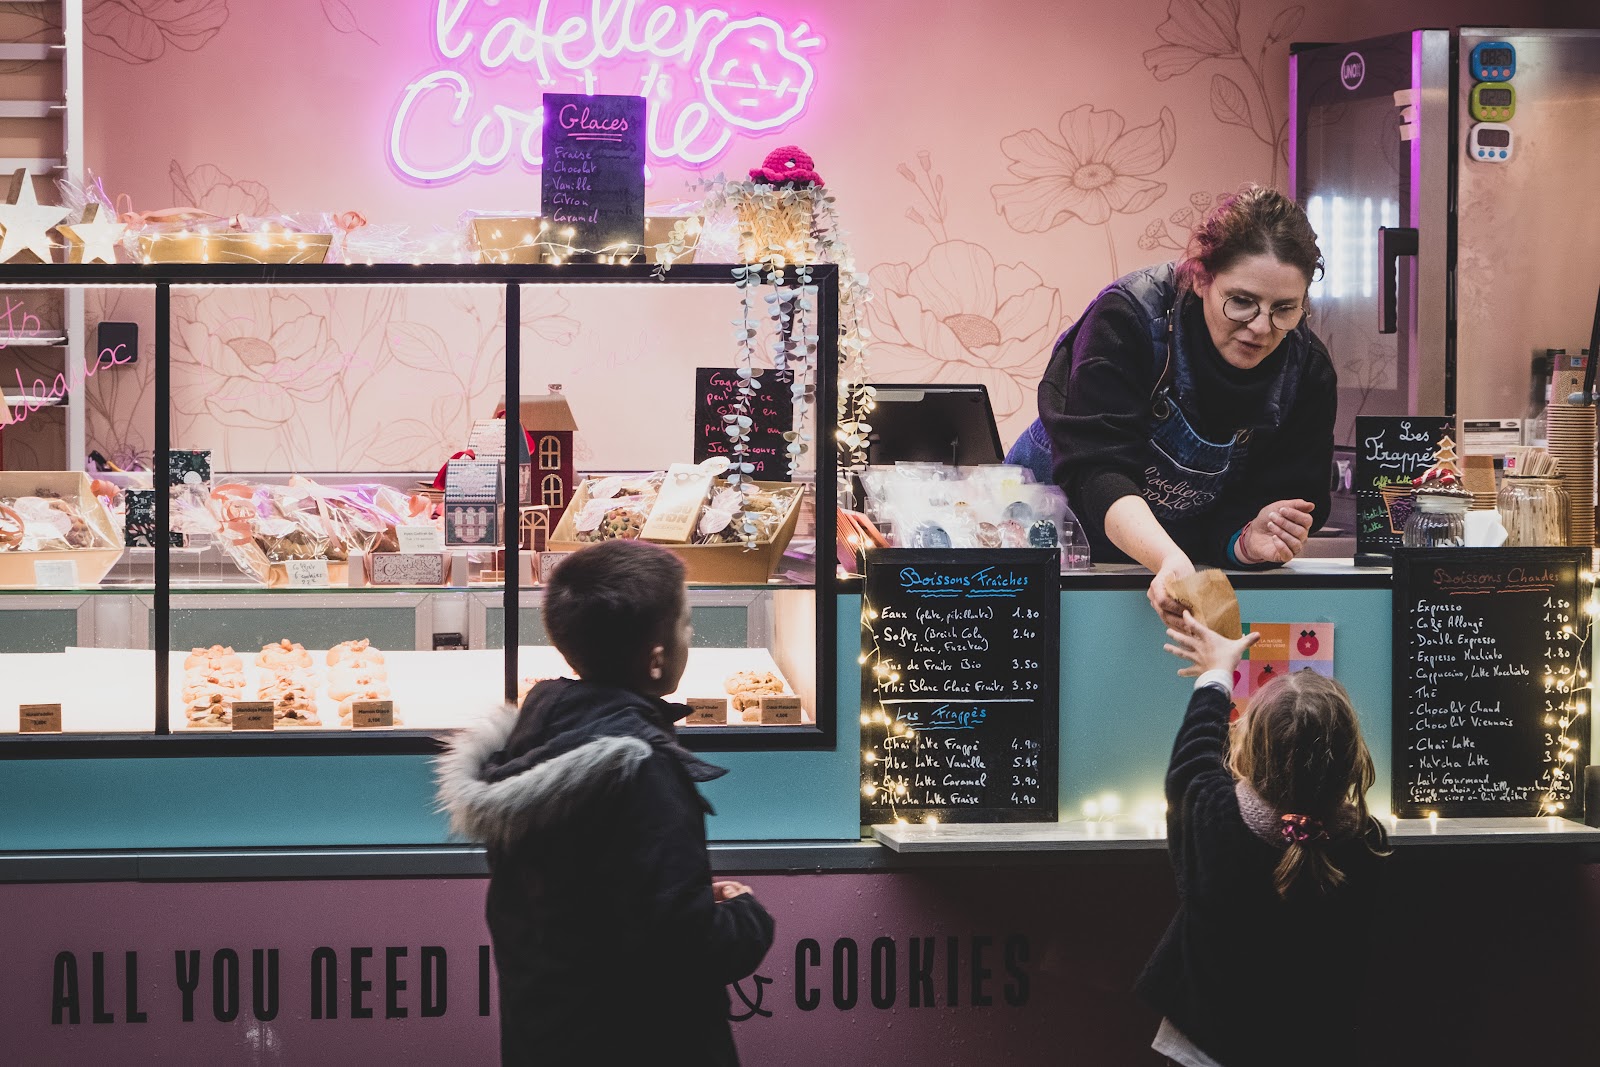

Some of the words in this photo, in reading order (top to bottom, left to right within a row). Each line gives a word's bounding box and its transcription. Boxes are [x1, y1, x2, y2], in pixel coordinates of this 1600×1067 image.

[436, 0, 729, 84] latelier
[559, 104, 629, 131] Glaces
[555, 146, 592, 159] Fraise
[554, 161, 597, 173] Chocolat
[552, 176, 592, 191] Vanille
[553, 193, 589, 206] Citron
[554, 207, 598, 224] Caramel
[0, 343, 131, 430] deaux
[1399, 420, 1430, 441] Les
[735, 447, 776, 455] oncours
[900, 567, 971, 587] Boissons
[1433, 567, 1501, 585] Boissons
[1507, 567, 1559, 583] Chaudes
[881, 606, 907, 619] Eaux
[1012, 607, 1040, 619] 1.80
[1417, 599, 1463, 617] Expresso
[1543, 597, 1570, 609] 1.50
[1448, 615, 1484, 634] Allongé
[1543, 613, 1569, 623] 1.90
[884, 627, 917, 647] Softs
[1012, 629, 1035, 639] 2.40
[1457, 634, 1496, 650] Expresso
[1545, 630, 1570, 641] 2.50
[907, 659, 920, 670] de
[960, 658, 982, 670] Bio
[1012, 658, 1039, 669] 3.50
[1417, 651, 1456, 669] Expresso
[1543, 647, 1571, 659] 1.80
[1471, 665, 1490, 678] Latte
[1544, 664, 1570, 675] 3.10
[909, 678, 939, 693] Blanc
[1012, 679, 1039, 691] 3.50
[1415, 685, 1438, 698] Thé
[1469, 701, 1501, 714] Chaud
[896, 706, 919, 721] Les
[931, 704, 987, 727] Frappés
[1470, 715, 1514, 727] Viennois
[1452, 736, 1476, 749] Latte
[915, 756, 940, 768] Latte
[945, 755, 986, 769] Vanille
[1419, 754, 1462, 769] Matcha
[1467, 752, 1490, 766] Latte
[915, 773, 937, 787] Latte
[943, 773, 987, 787] Caramel
[1012, 775, 1037, 786] 3.90
[1417, 771, 1438, 786] Lait
[1442, 772, 1490, 785] Gourmand
[1542, 769, 1570, 781] 450
[951, 793, 980, 805] Fraise
[1011, 793, 1036, 804] 4.90
[1549, 792, 1571, 801] 0.50
[51, 951, 148, 1025] ALL
[175, 947, 280, 1023] YOU
[310, 945, 448, 1020] NEED
[794, 932, 1031, 1012] COOKIES
